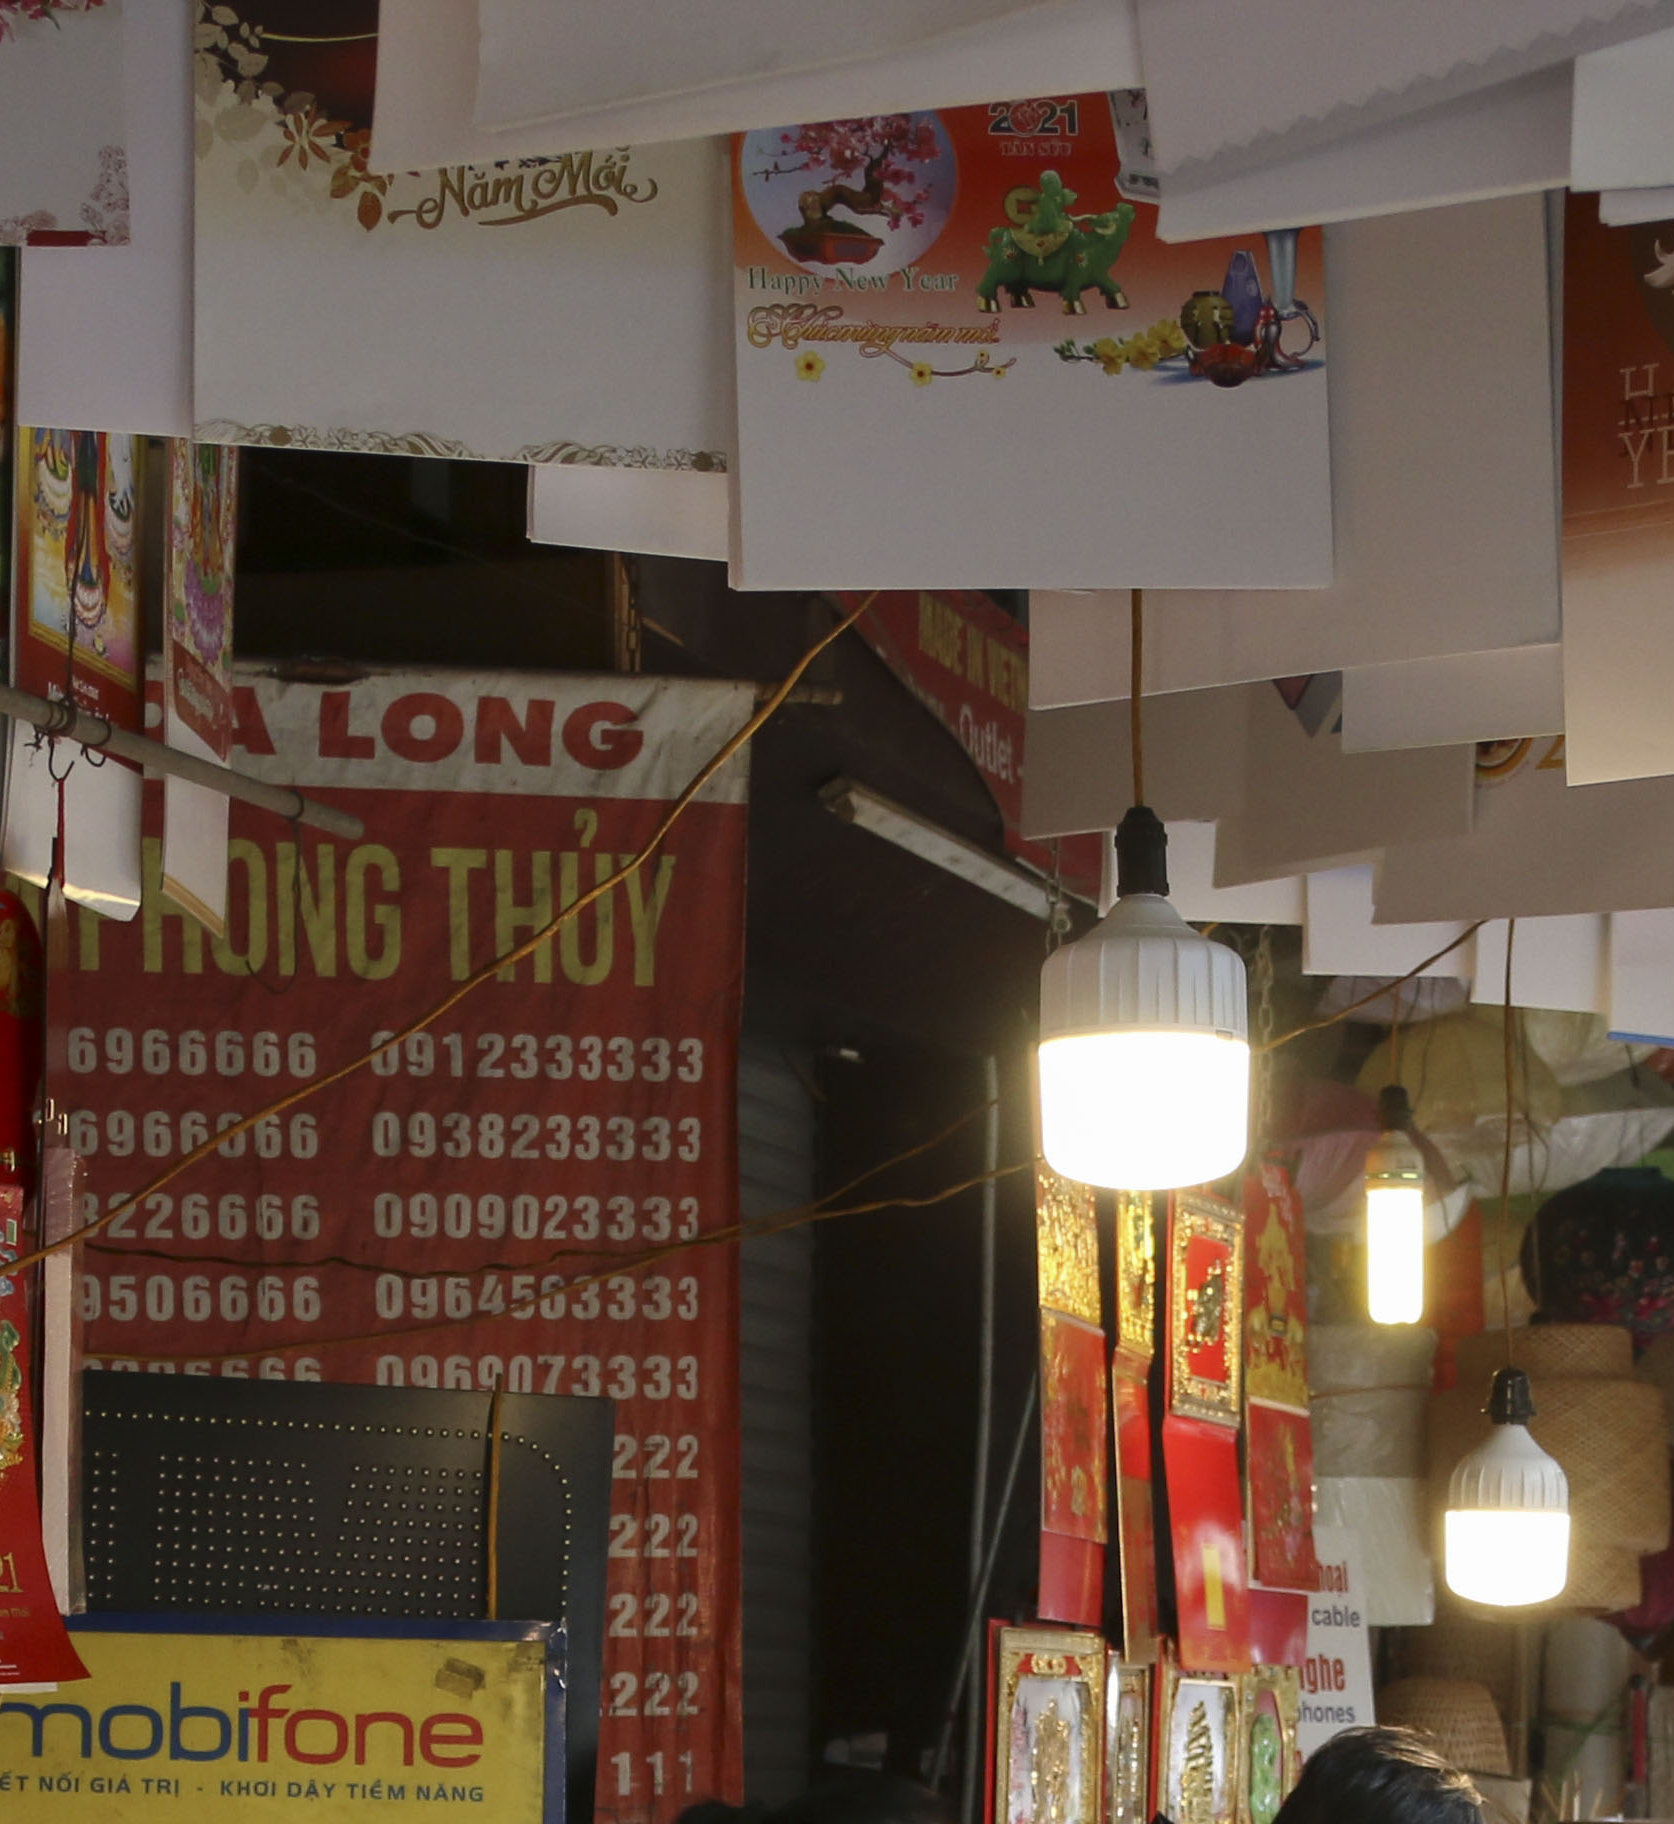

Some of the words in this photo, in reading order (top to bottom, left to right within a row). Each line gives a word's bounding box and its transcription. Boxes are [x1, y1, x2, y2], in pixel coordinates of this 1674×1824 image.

[988, 98, 1079, 138] 2021
[390, 150, 527, 230] Năm
[747, 266, 822, 296] Happy
[831, 267, 890, 293] New
[898, 266, 959, 293] Year
[318, 689, 645, 771] LONG
[959, 703, 1014, 785] Outlet
[431, 808, 677, 989] THỦY
[371, 1030, 705, 1085] 0912333333
[372, 1112, 702, 1165] 0938233333
[373, 1193, 701, 1243] 0909023333
[1311, 1604, 1361, 1629] cable
[39, 1772, 80, 1793] NỐI
[141, 1778, 180, 1798] TRỊ
